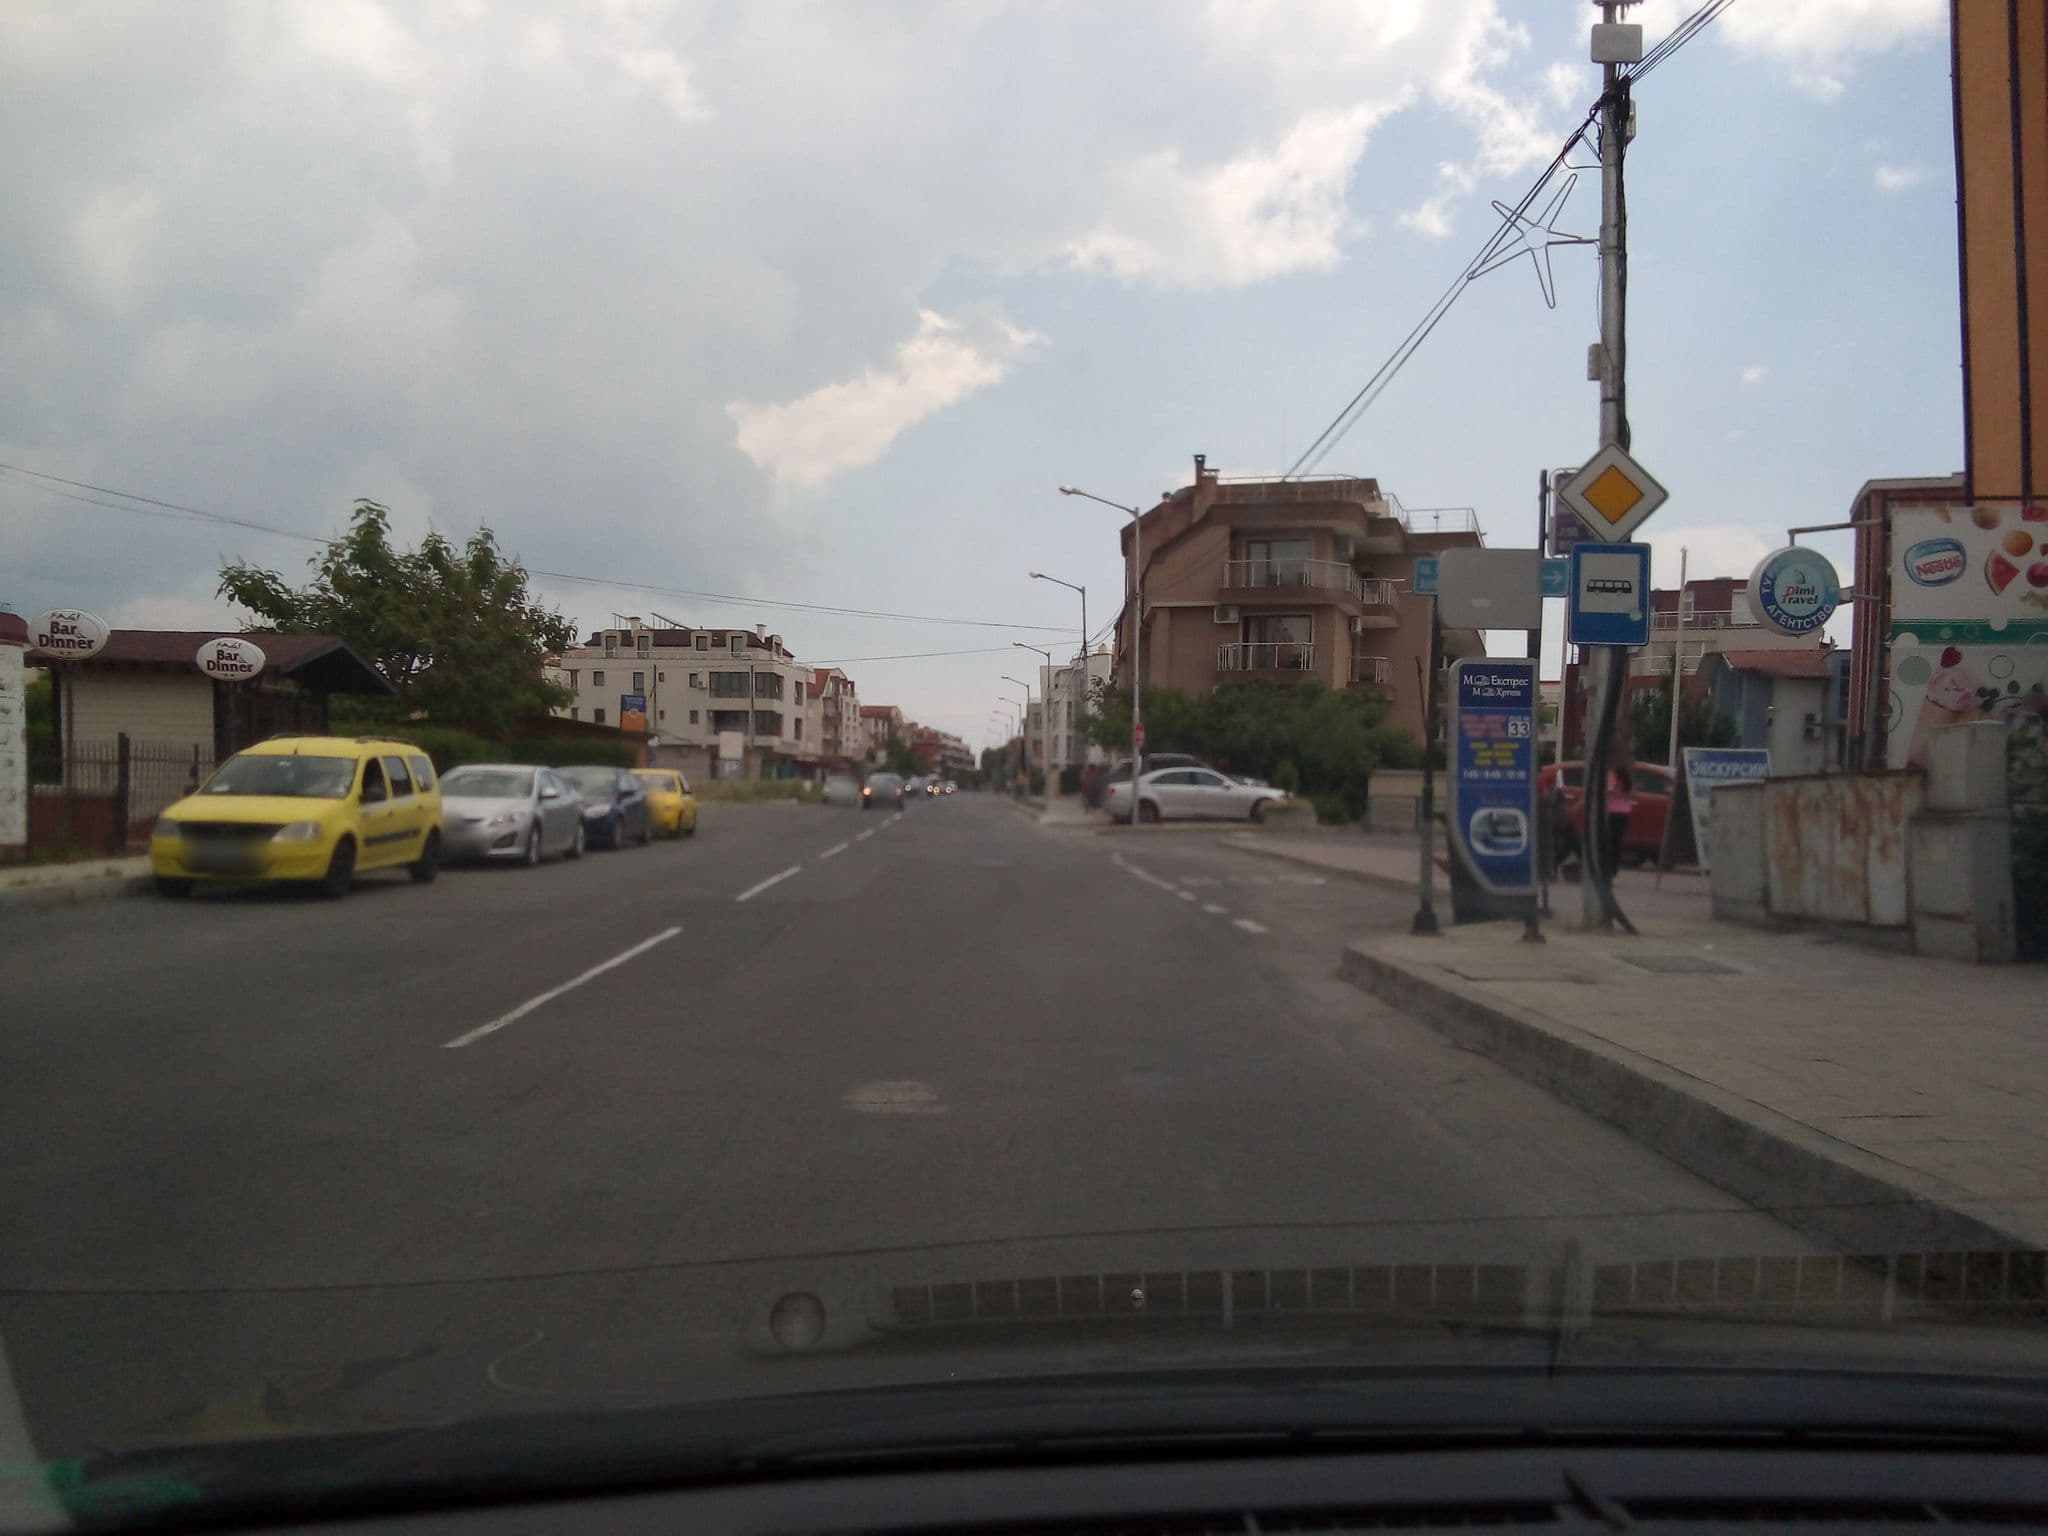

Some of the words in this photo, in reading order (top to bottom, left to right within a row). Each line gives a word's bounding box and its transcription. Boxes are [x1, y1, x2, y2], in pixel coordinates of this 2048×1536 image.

[1781, 595, 1819, 604] Travel
[1767, 604, 1833, 629] АГЕНТСТВО
[50, 621, 77, 634] Bar
[39, 634, 94, 649] Dinner
[216, 649, 239, 661] Bar
[206, 660, 253, 672] Dinner
